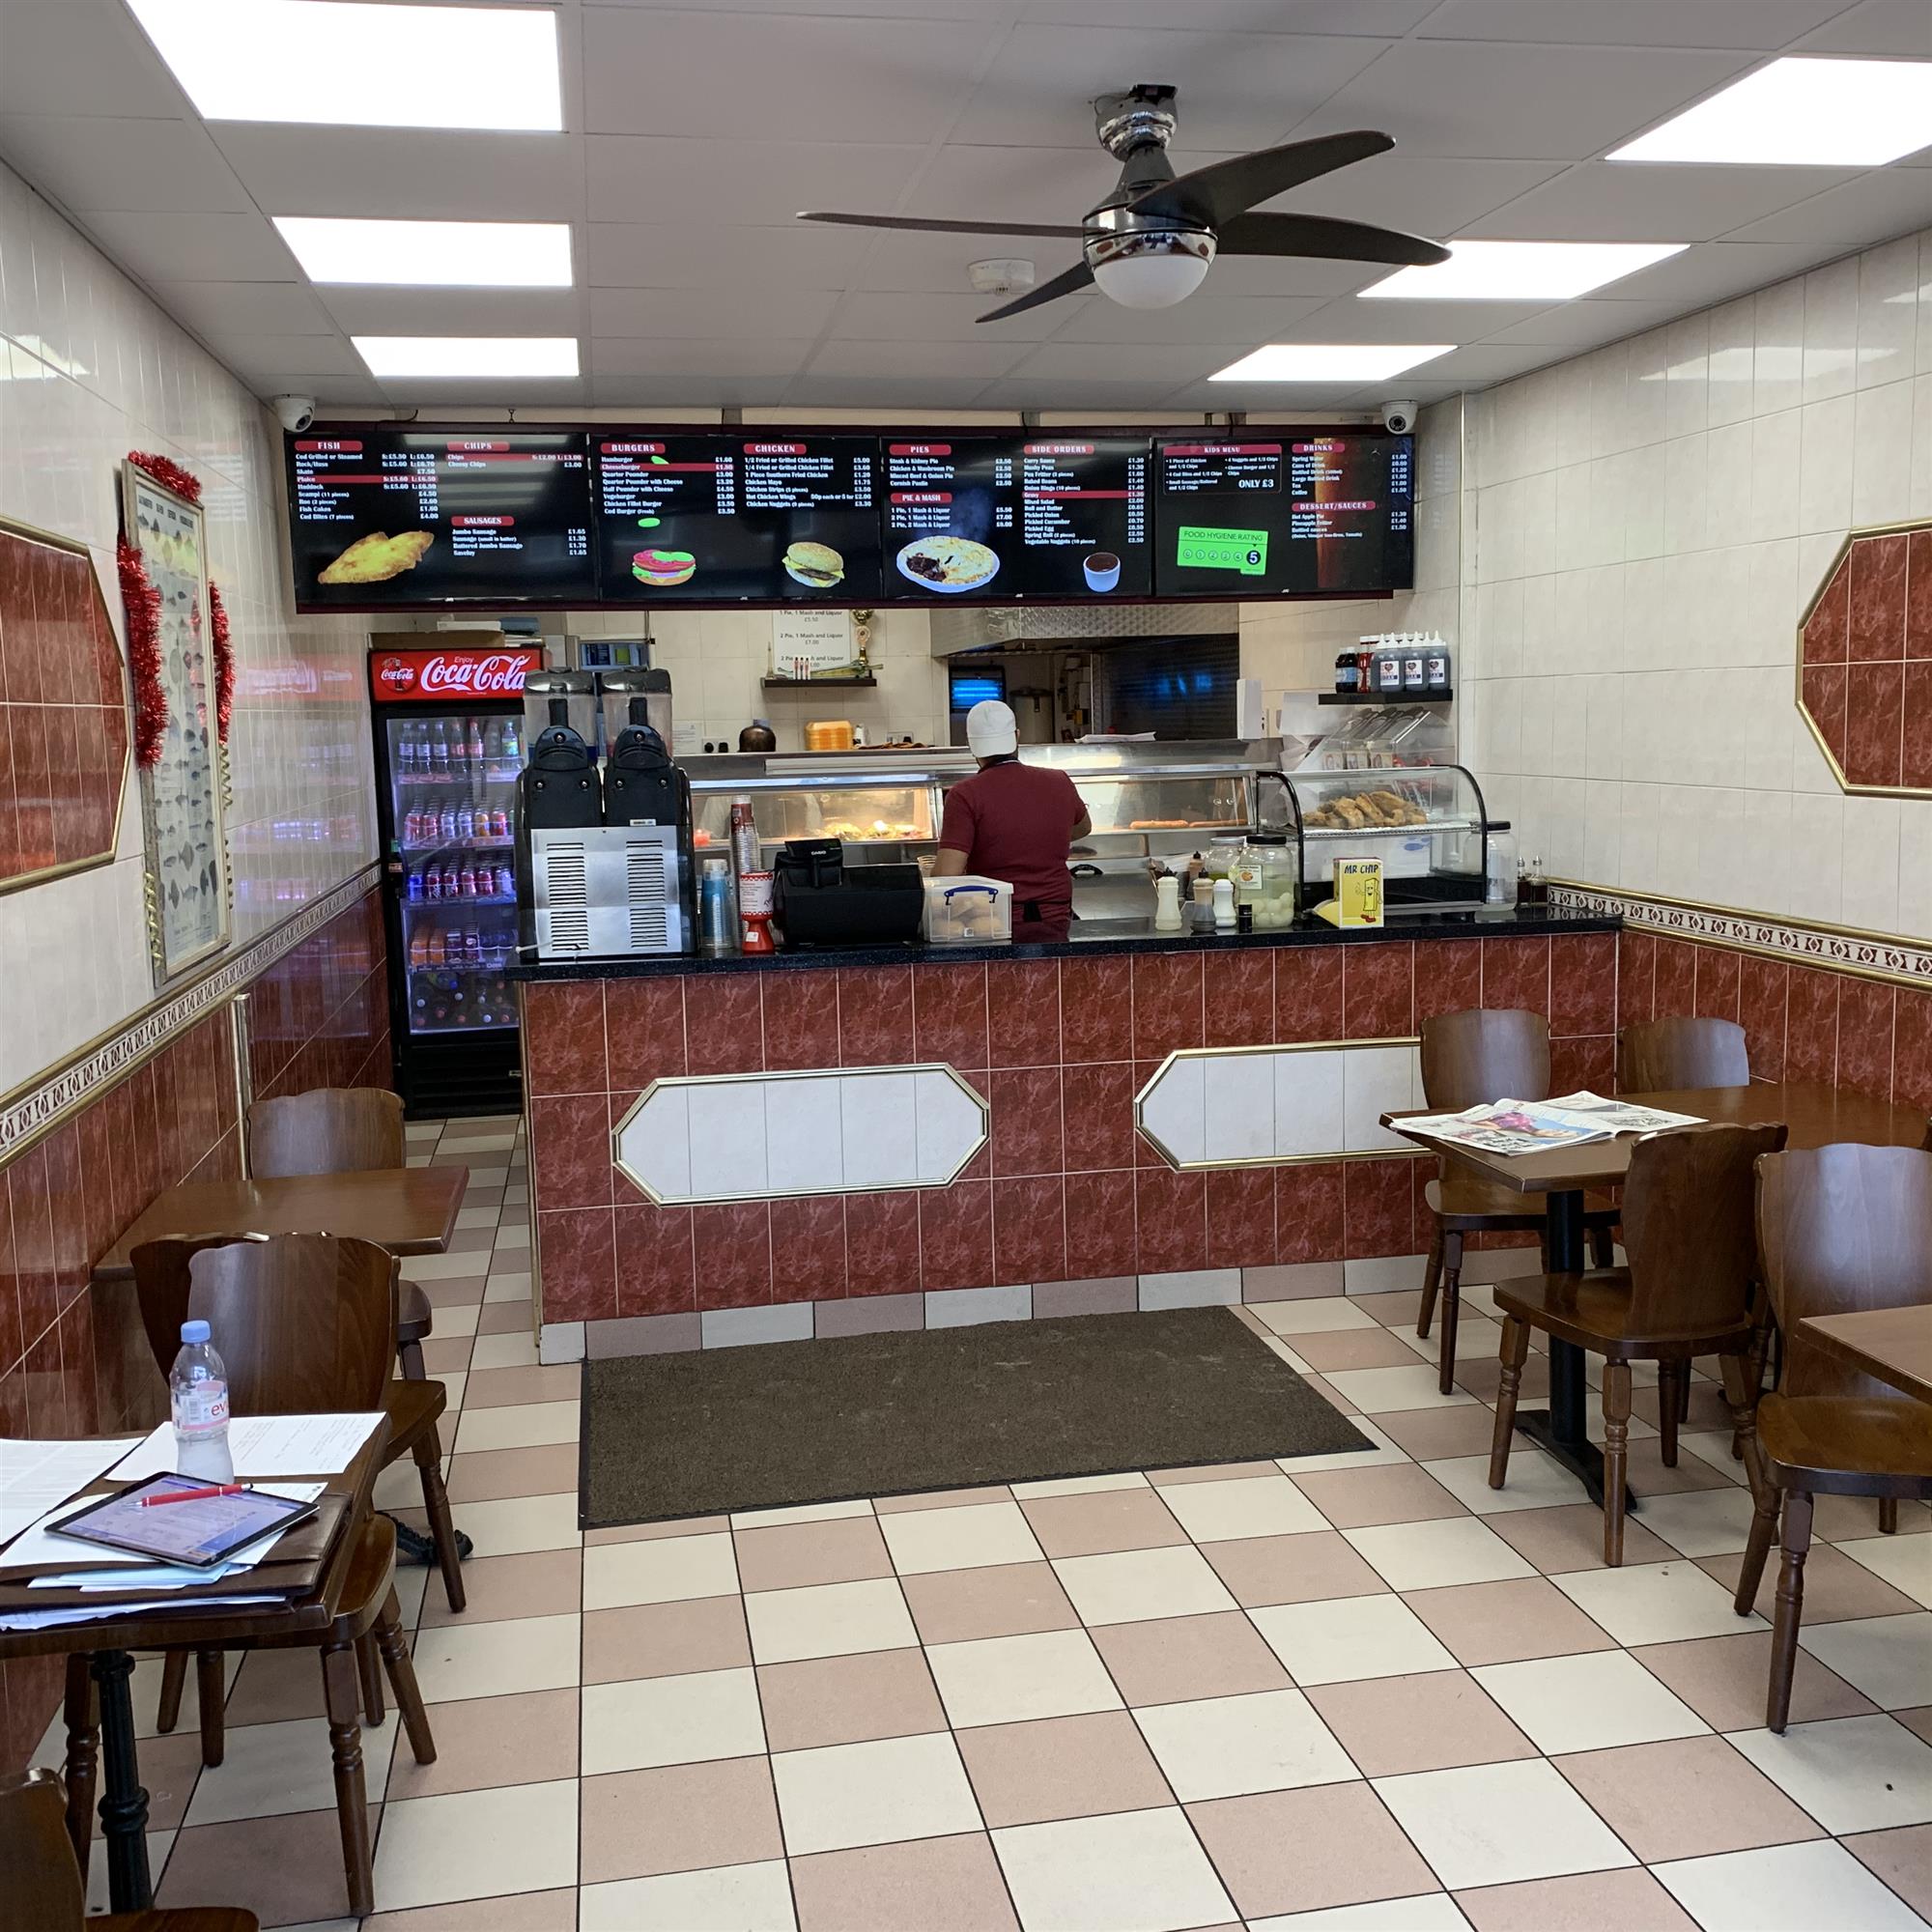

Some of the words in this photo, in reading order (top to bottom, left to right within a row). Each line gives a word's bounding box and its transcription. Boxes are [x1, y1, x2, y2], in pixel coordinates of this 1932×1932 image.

[1249, 553, 1258, 563] 5
[381, 668, 413, 680] Coca-Cola
[421, 655, 531, 692] Coca-Cola
[1360, 865, 1378, 873] CHIP
